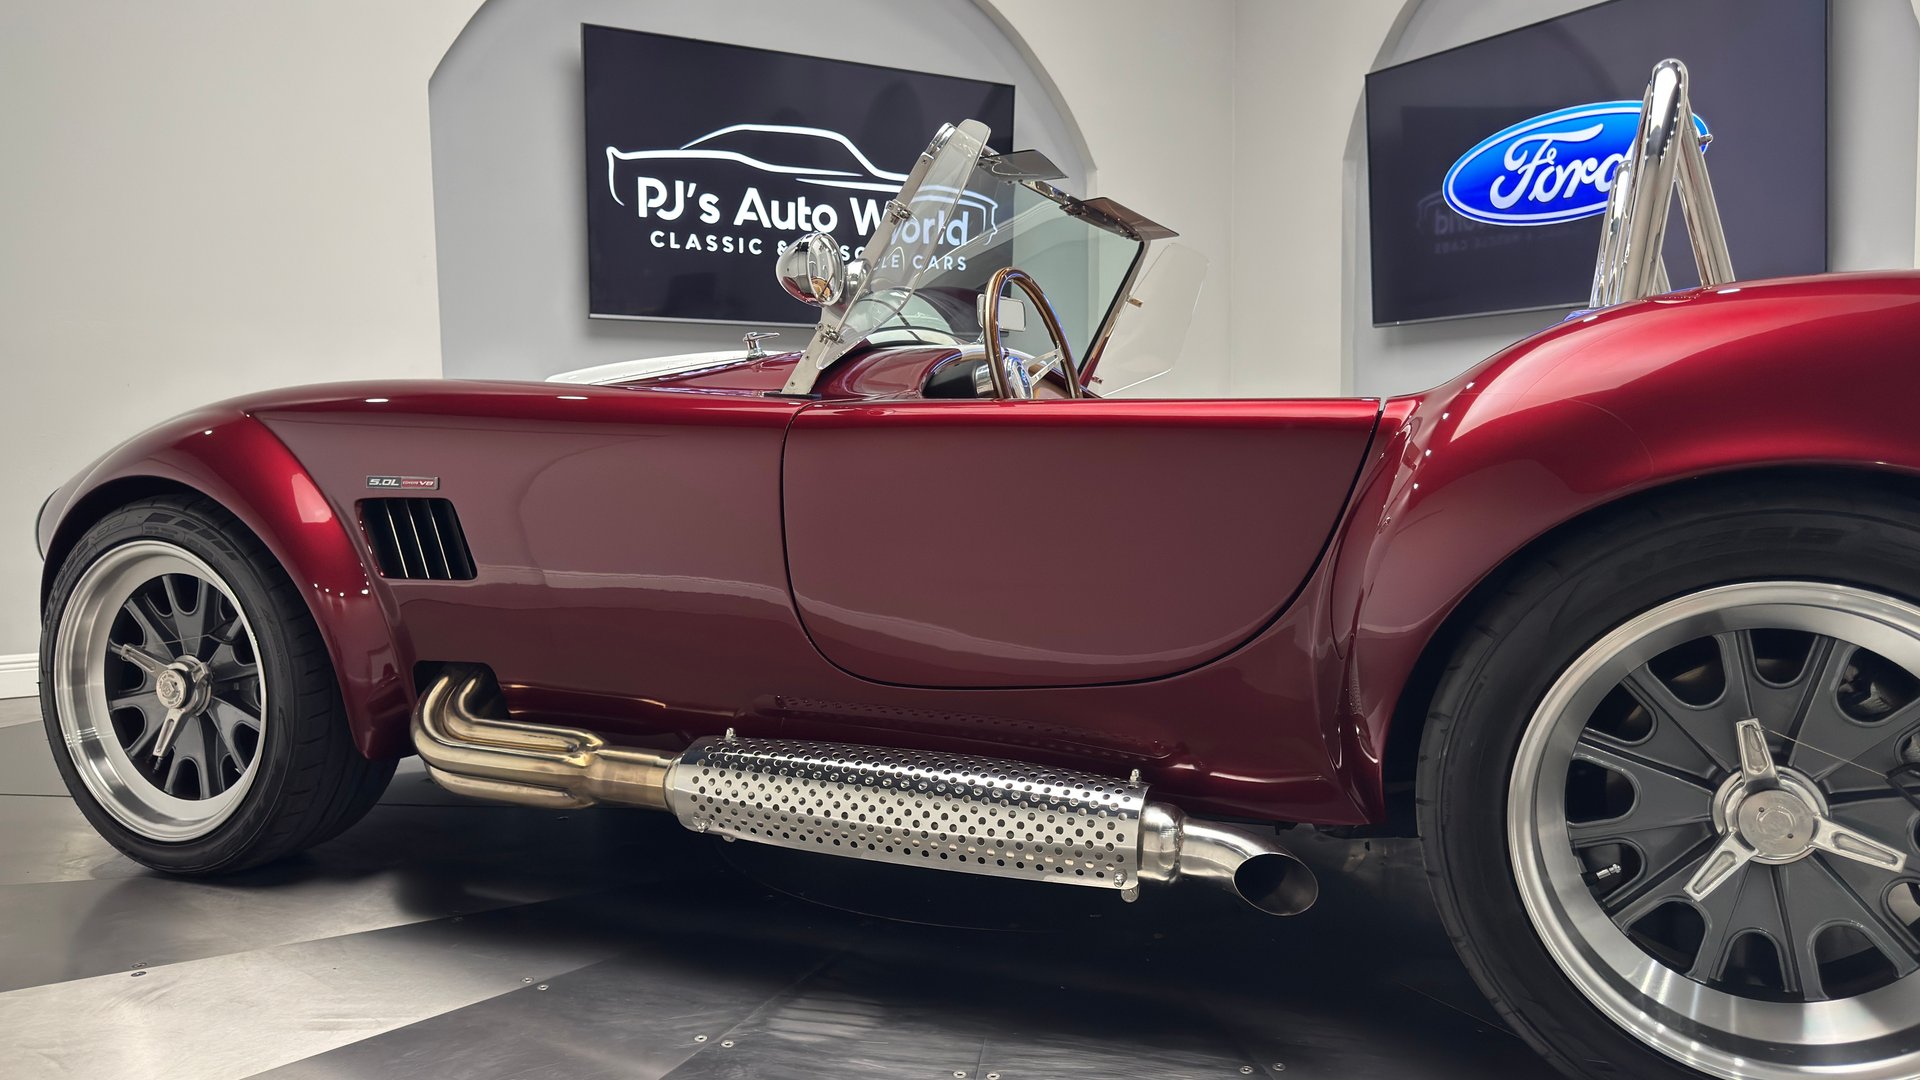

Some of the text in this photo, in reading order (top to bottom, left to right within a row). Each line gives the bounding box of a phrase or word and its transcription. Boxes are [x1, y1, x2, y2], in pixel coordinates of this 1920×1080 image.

[637, 176, 969, 246] PJ's Auto World
[650, 230, 762, 255] CLASSIC
[913, 255, 967, 271] CARS
[369, 478, 399, 486] 5.0L
